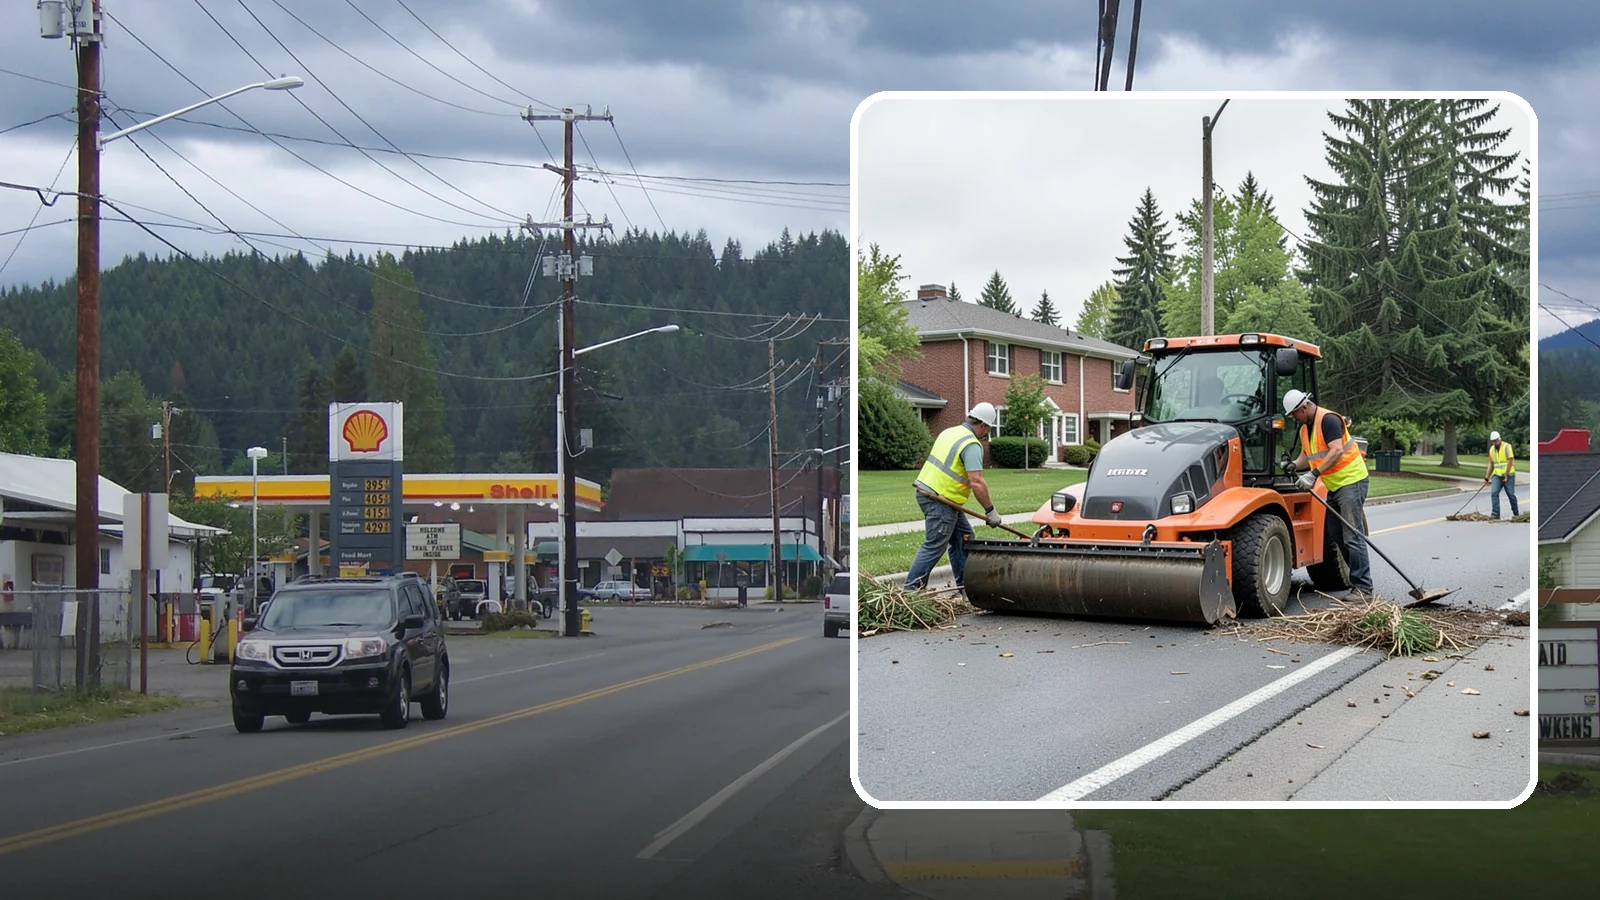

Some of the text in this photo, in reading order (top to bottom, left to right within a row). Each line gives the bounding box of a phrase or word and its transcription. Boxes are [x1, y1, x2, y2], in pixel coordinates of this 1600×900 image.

[366, 480, 384, 490] 395
[490, 484, 547, 499] Shell
[365, 494, 384, 504] 405
[365, 508, 383, 518] 415
[365, 522, 383, 533] 429
